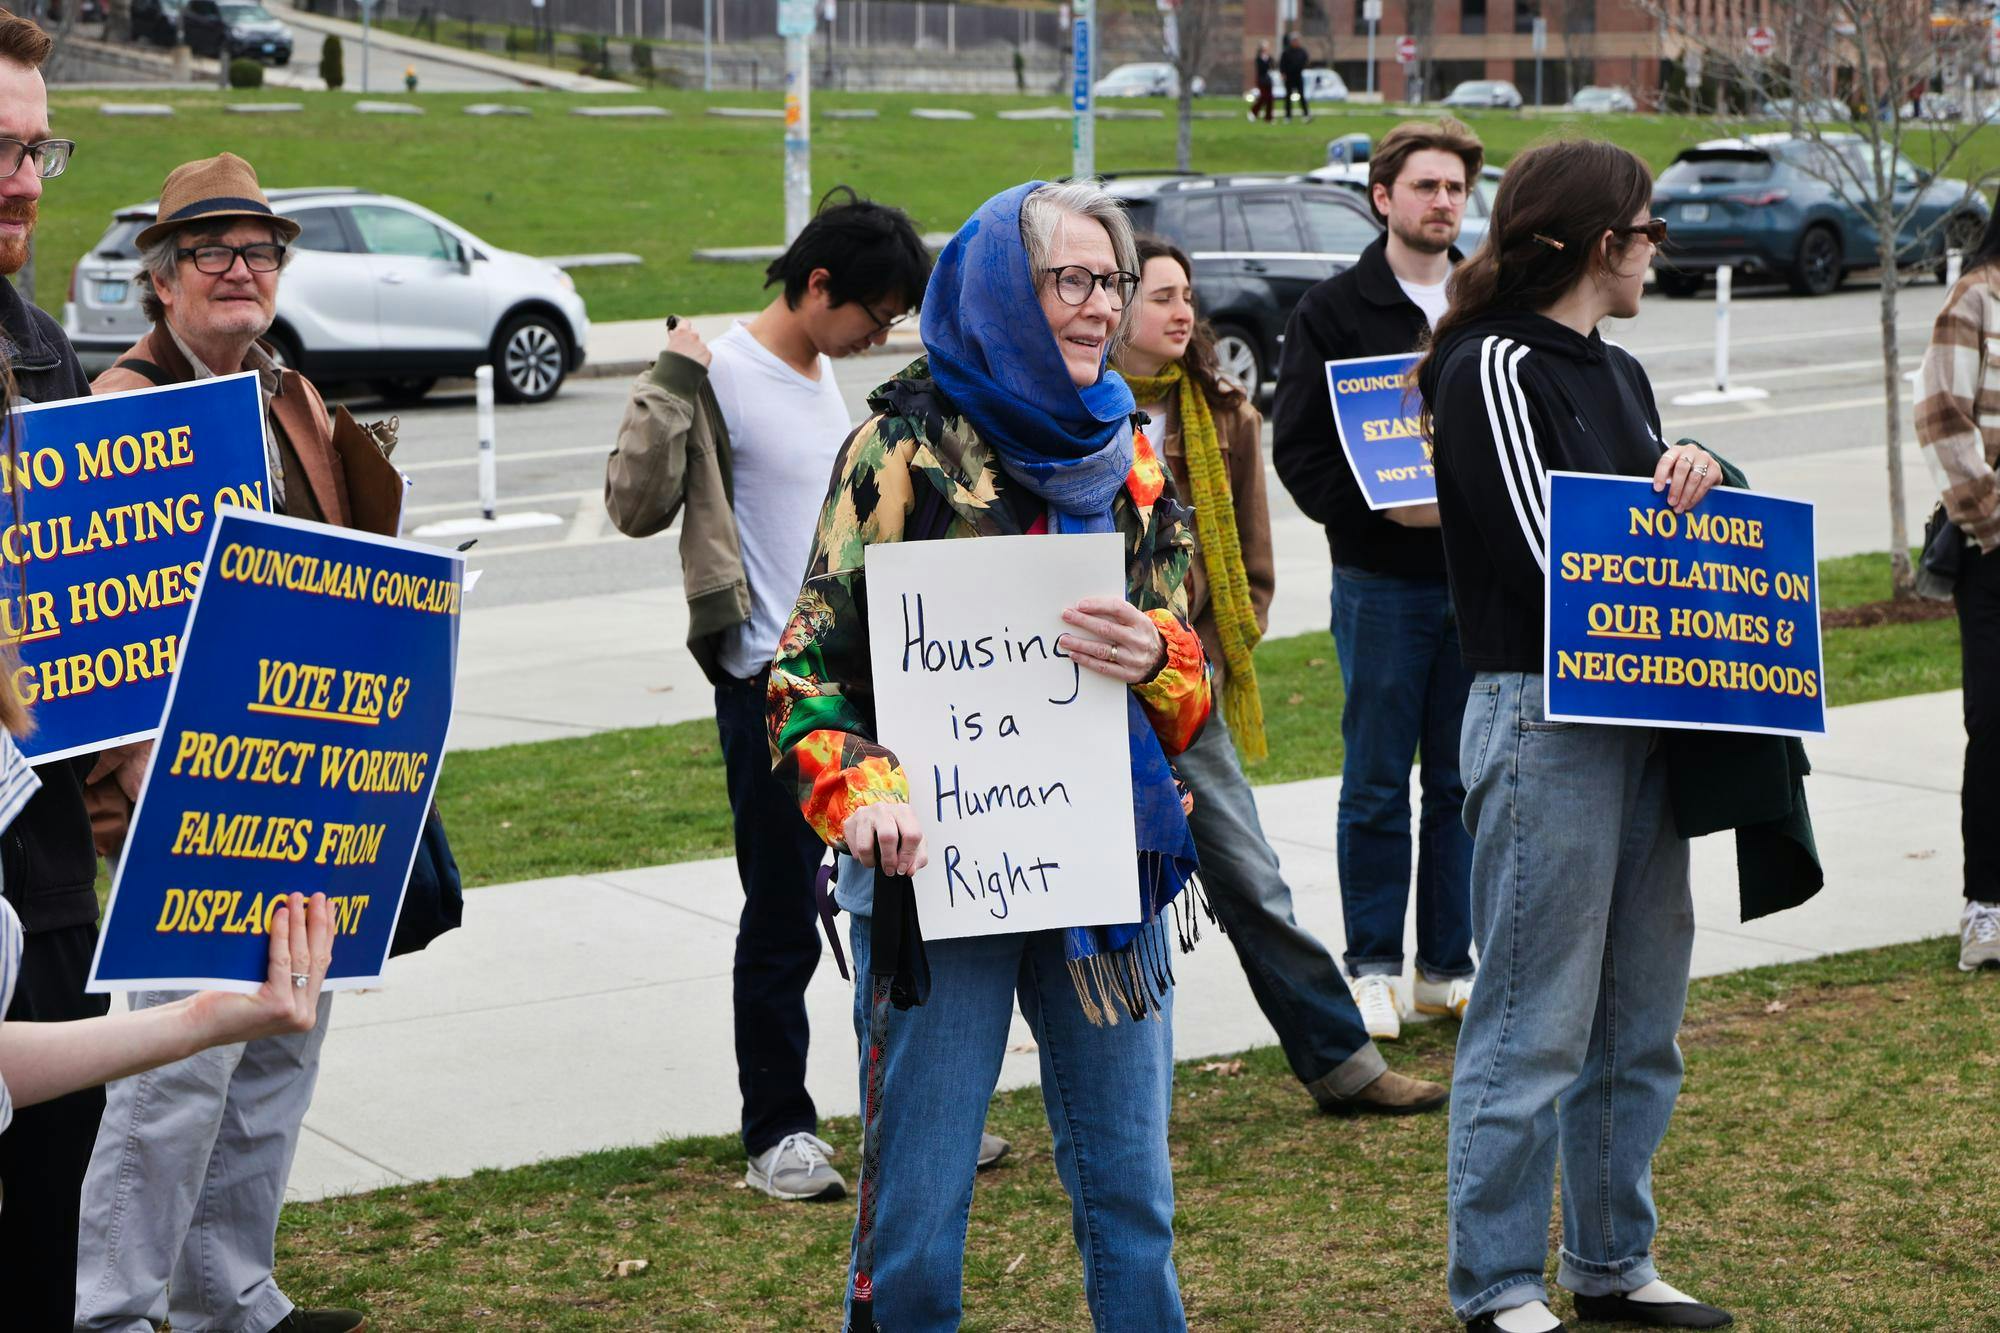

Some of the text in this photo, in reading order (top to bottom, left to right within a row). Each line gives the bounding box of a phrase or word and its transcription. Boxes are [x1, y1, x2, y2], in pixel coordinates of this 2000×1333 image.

[1337, 373, 1419, 394] COUNCIL
[1362, 416, 1434, 435] STAN
[0, 425, 194, 494] NO MORE
[1375, 466, 1418, 482] NOT
[0, 493, 204, 566] CULATING
[1630, 508, 1764, 549] NO MORE
[0, 561, 204, 634] UR HOMES
[220, 542, 461, 616] COUNCILMAN GONCALVE
[1560, 551, 1809, 601] SPECULATING ON
[901, 592, 1080, 705] Housing
[1586, 602, 1795, 648] OUR HOMES &
[8, 633, 178, 709] GHBORH
[256, 658, 411, 719] VOTE YES &
[1556, 650, 1818, 698] NEIGHBORHOODS
[949, 703, 1021, 741] is a
[170, 730, 428, 794] PROTECT WORKING
[932, 763, 1073, 823] Human
[171, 811, 386, 866] FAMILIES FROM
[943, 844, 1061, 920] Right
